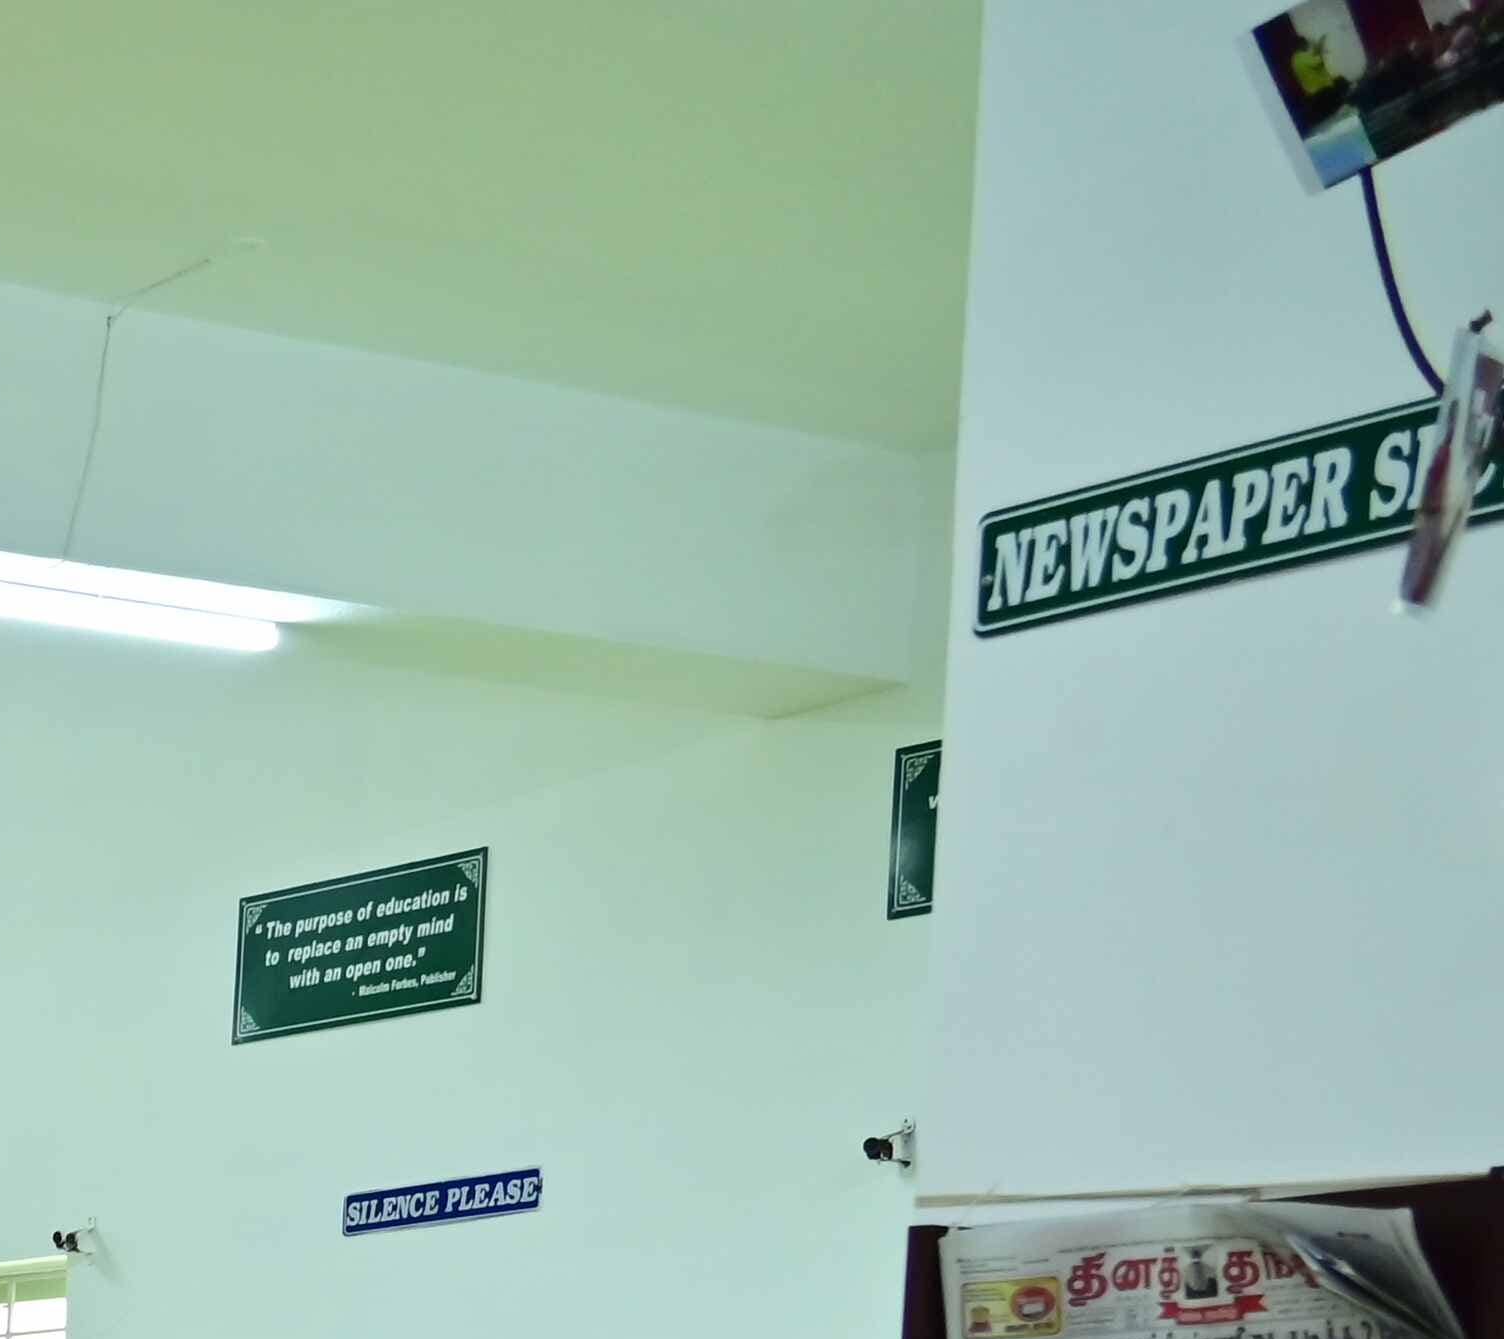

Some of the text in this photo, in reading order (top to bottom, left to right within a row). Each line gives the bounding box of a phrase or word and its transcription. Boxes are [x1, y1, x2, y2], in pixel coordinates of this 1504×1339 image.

[987, 447, 1352, 612] NEWSPAPER
[266, 884, 468, 939] The purpose of education is
[265, 914, 454, 967] to replace an empty mind
[289, 968, 320, 989] with
[324, 966, 341, 982] an
[346, 960, 380, 981] open
[347, 1177, 538, 1226] SILENCE PLEASE
